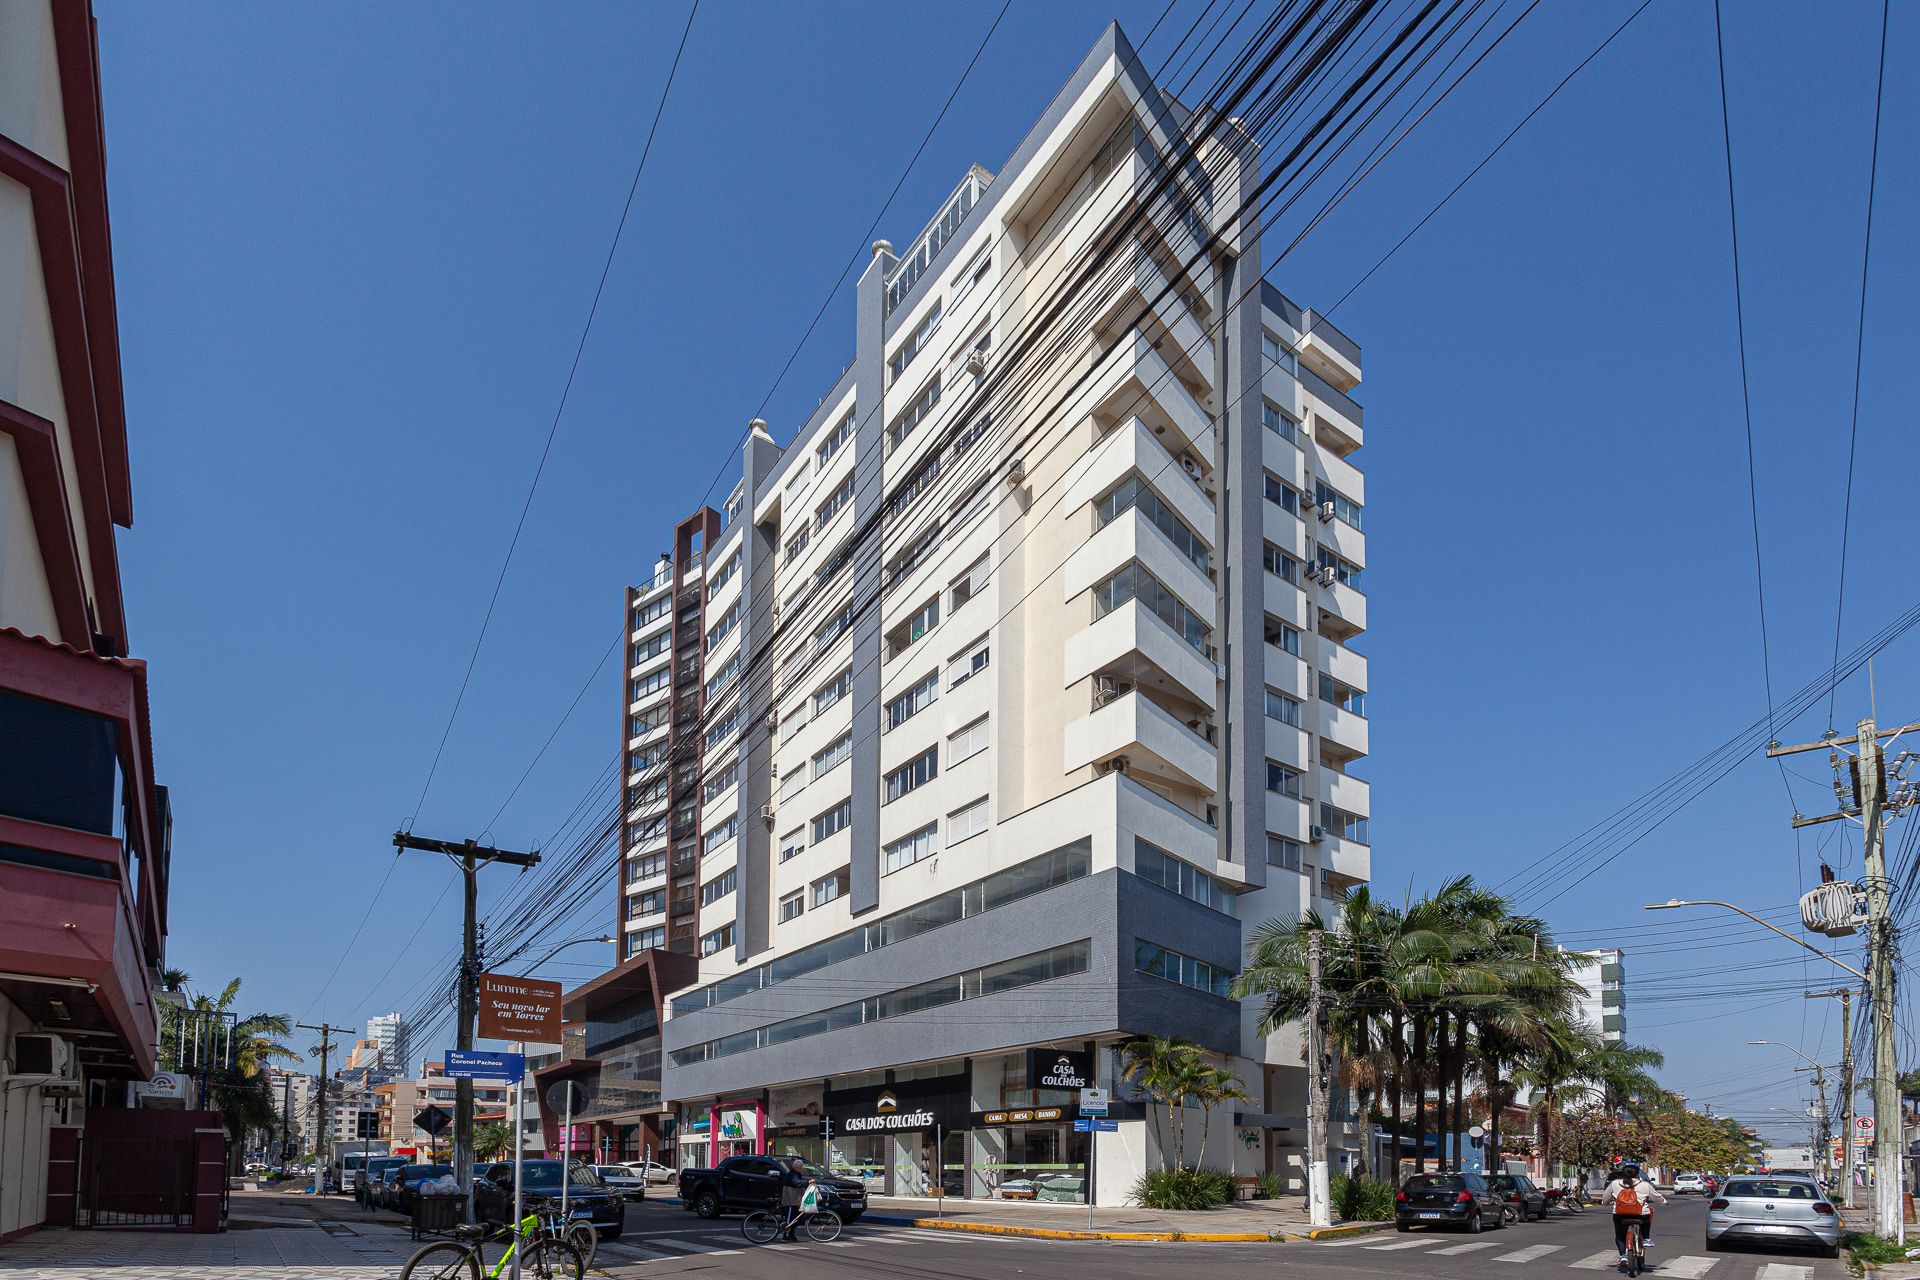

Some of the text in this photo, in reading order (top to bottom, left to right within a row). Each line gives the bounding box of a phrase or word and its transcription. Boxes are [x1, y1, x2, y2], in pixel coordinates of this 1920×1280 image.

[486, 980, 528, 995] Lumme
[491, 1000, 550, 1013] Seu novo lar
[497, 1010, 544, 1021] em Torres
[1053, 1064, 1075, 1075] CASA
[1041, 1075, 1086, 1087] COLCHÕES
[845, 1108, 934, 1131] CASA DOS COLCHÕES
[988, 1110, 1056, 1122] CAMA MESA BANHO
